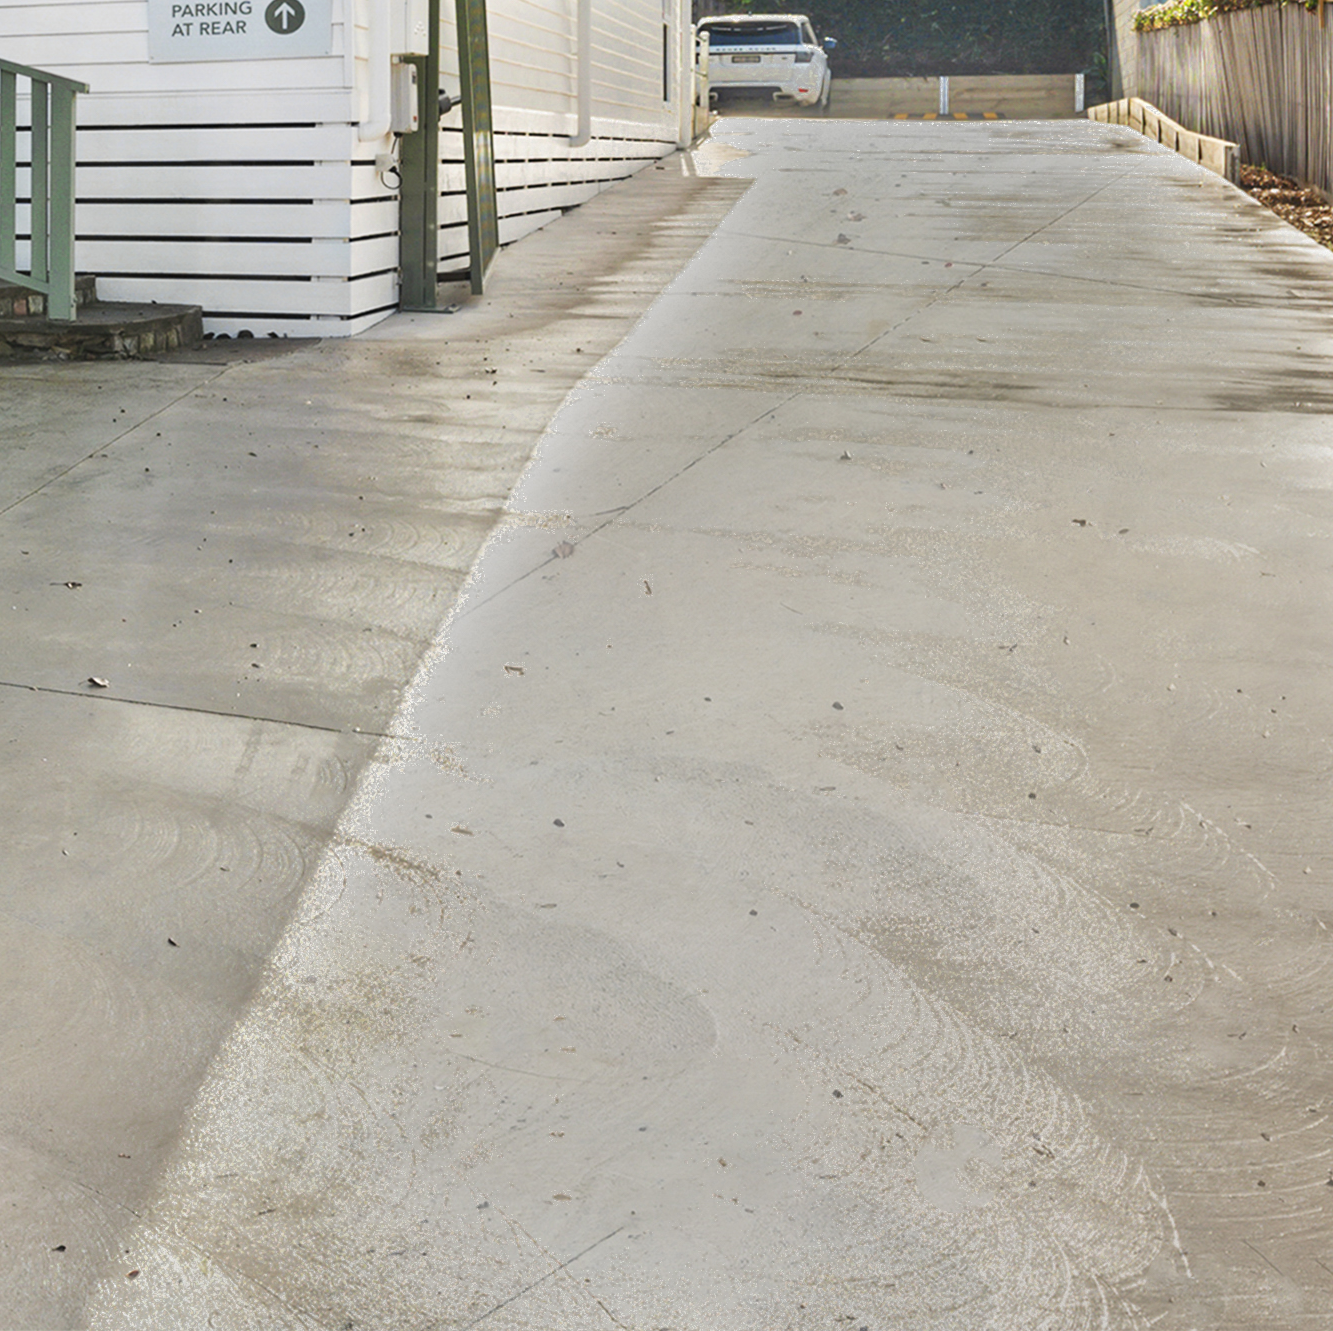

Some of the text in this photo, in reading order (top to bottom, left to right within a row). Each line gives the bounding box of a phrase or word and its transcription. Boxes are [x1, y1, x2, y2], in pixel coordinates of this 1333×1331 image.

[171, 0, 253, 19] PARKING
[171, 20, 247, 38] AT REAR
